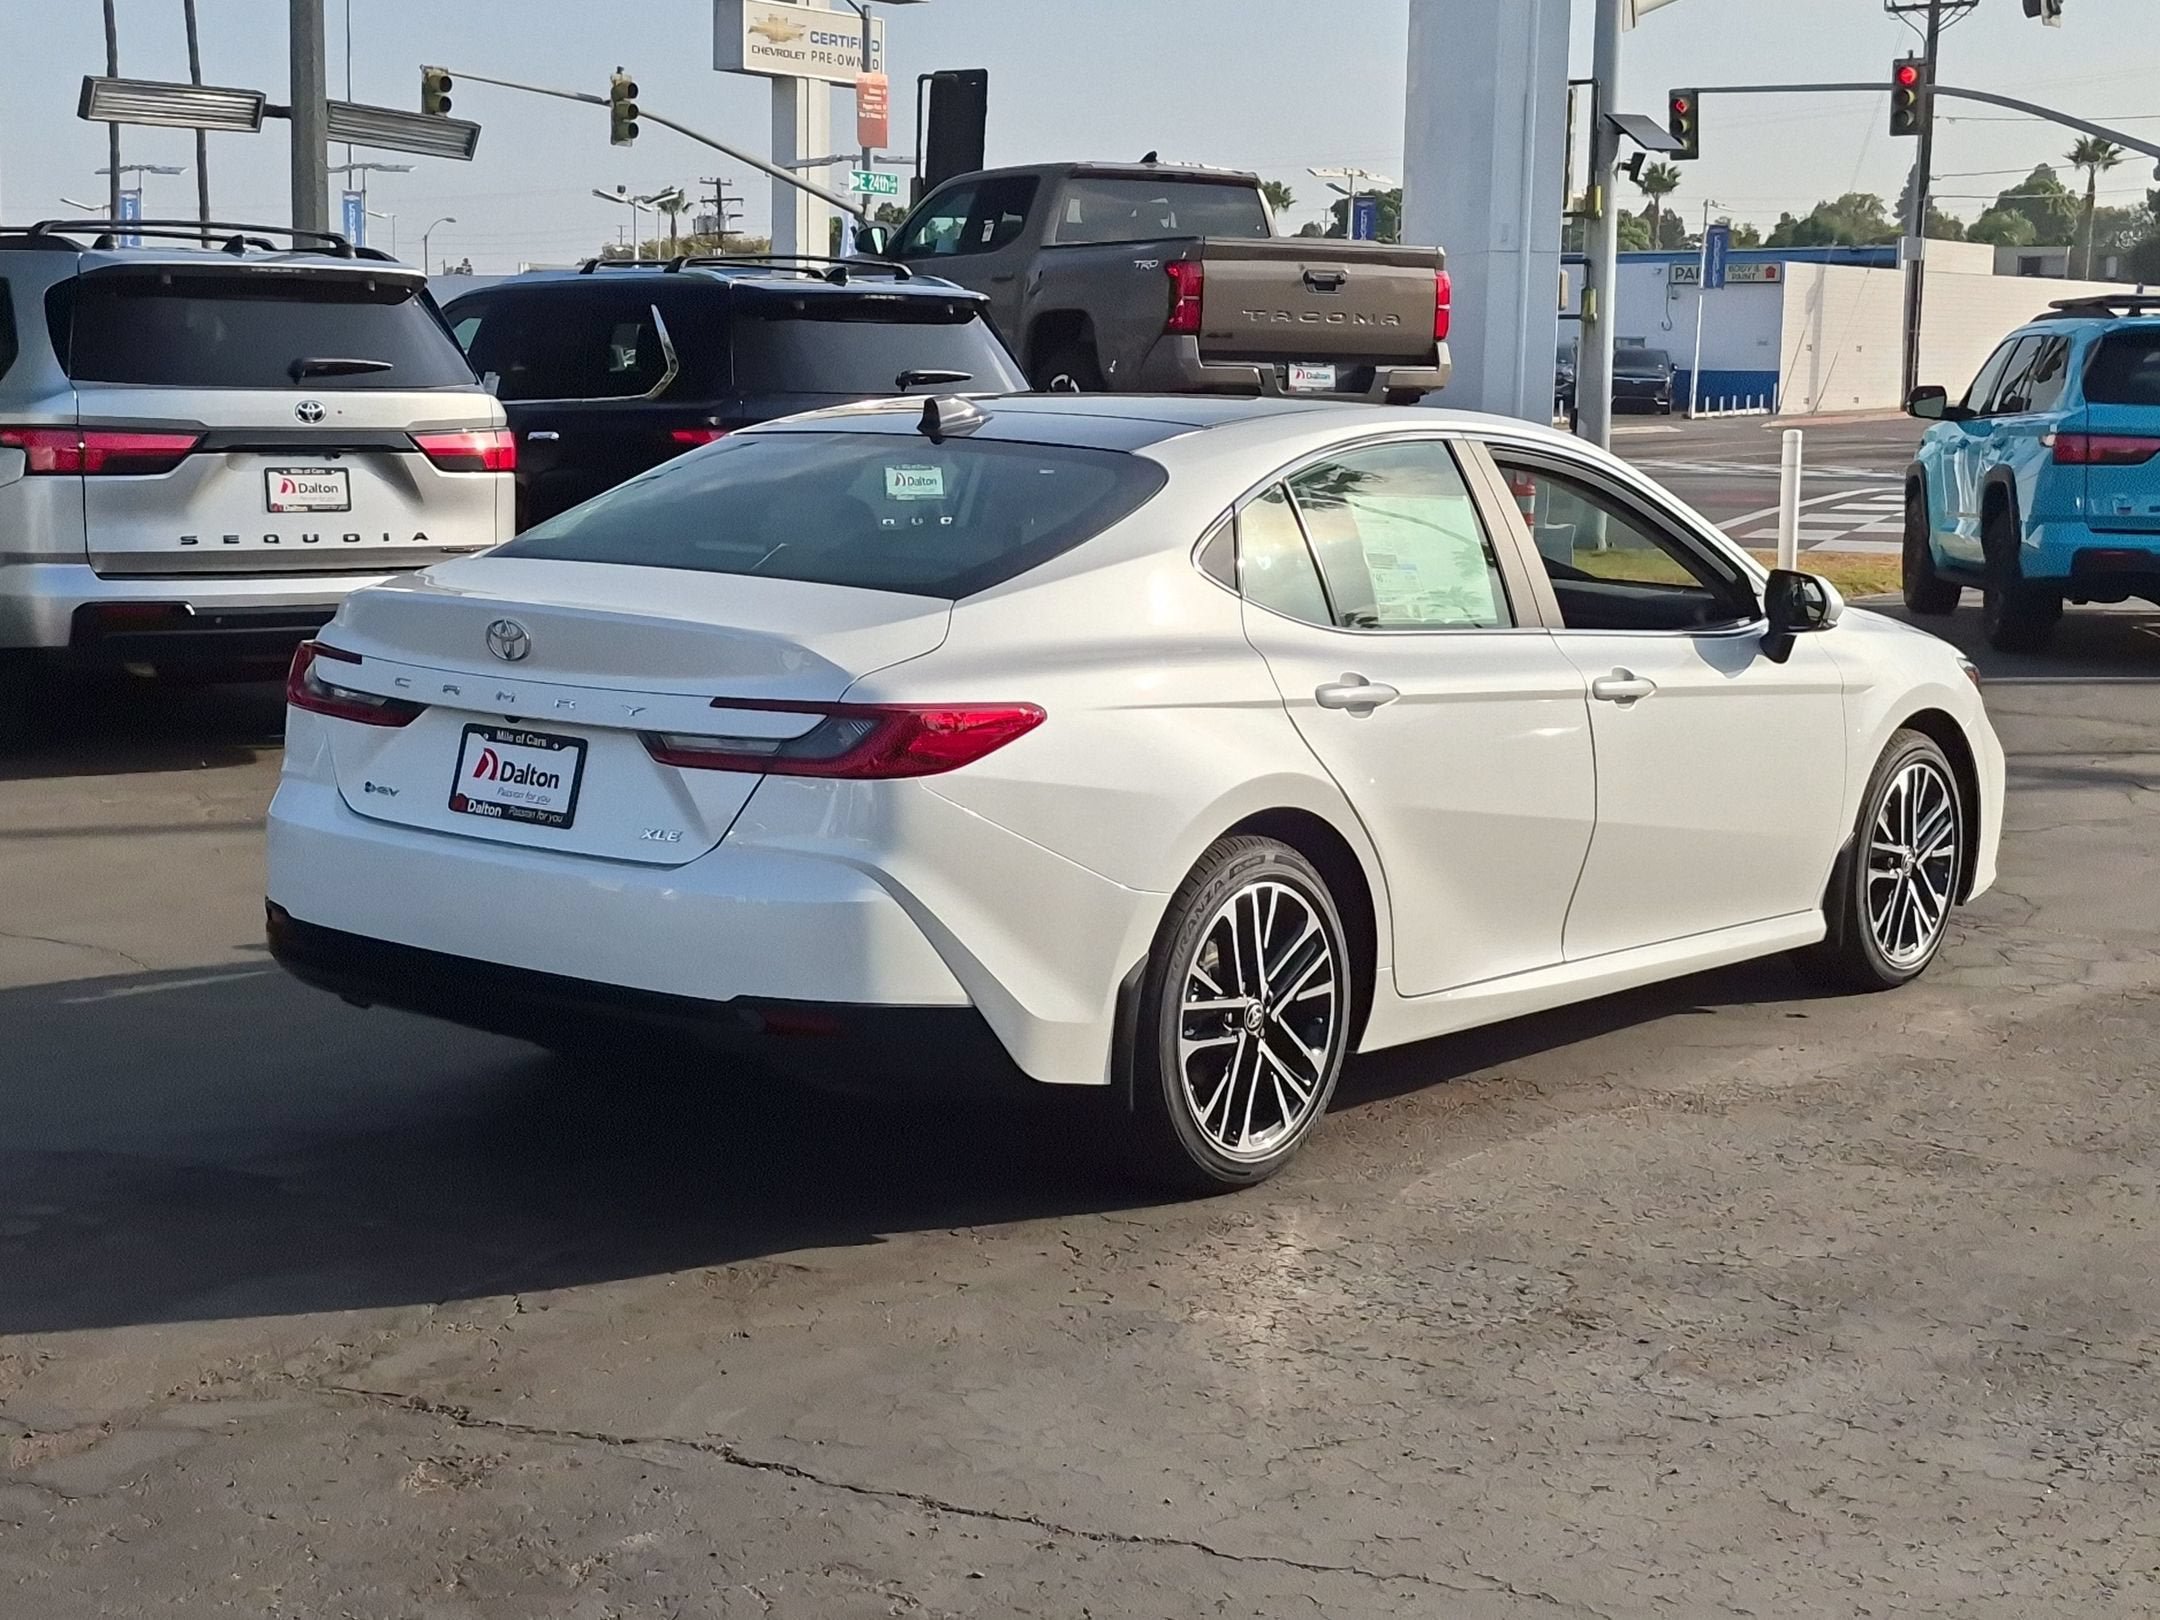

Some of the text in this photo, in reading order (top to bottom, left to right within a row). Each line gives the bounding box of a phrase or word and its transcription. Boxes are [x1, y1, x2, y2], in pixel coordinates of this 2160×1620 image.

[809, 31, 880, 53] CERTIFID
[751, 44, 806, 60] CHEVROLET
[811, 50, 879, 70] PRE-OWND
[860, 174, 867, 190] E
[869, 174, 889, 192] 24th
[1133, 259, 1159, 270] TRD
[1242, 309, 1401, 326] TACOMA
[298, 482, 339, 494] Dalton
[907, 476, 937, 486] Dalton
[180, 531, 429, 545] SEQUOIA
[394, 676, 647, 717] CAMRY
[496, 729, 547, 747] Mile of Cars
[499, 760, 560, 790] Dalton
[525, 790, 537, 801] for
[467, 799, 503, 817] Dalton
[536, 810, 548, 820] for
[548, 813, 564, 823] you
[640, 828, 682, 842] XLE
